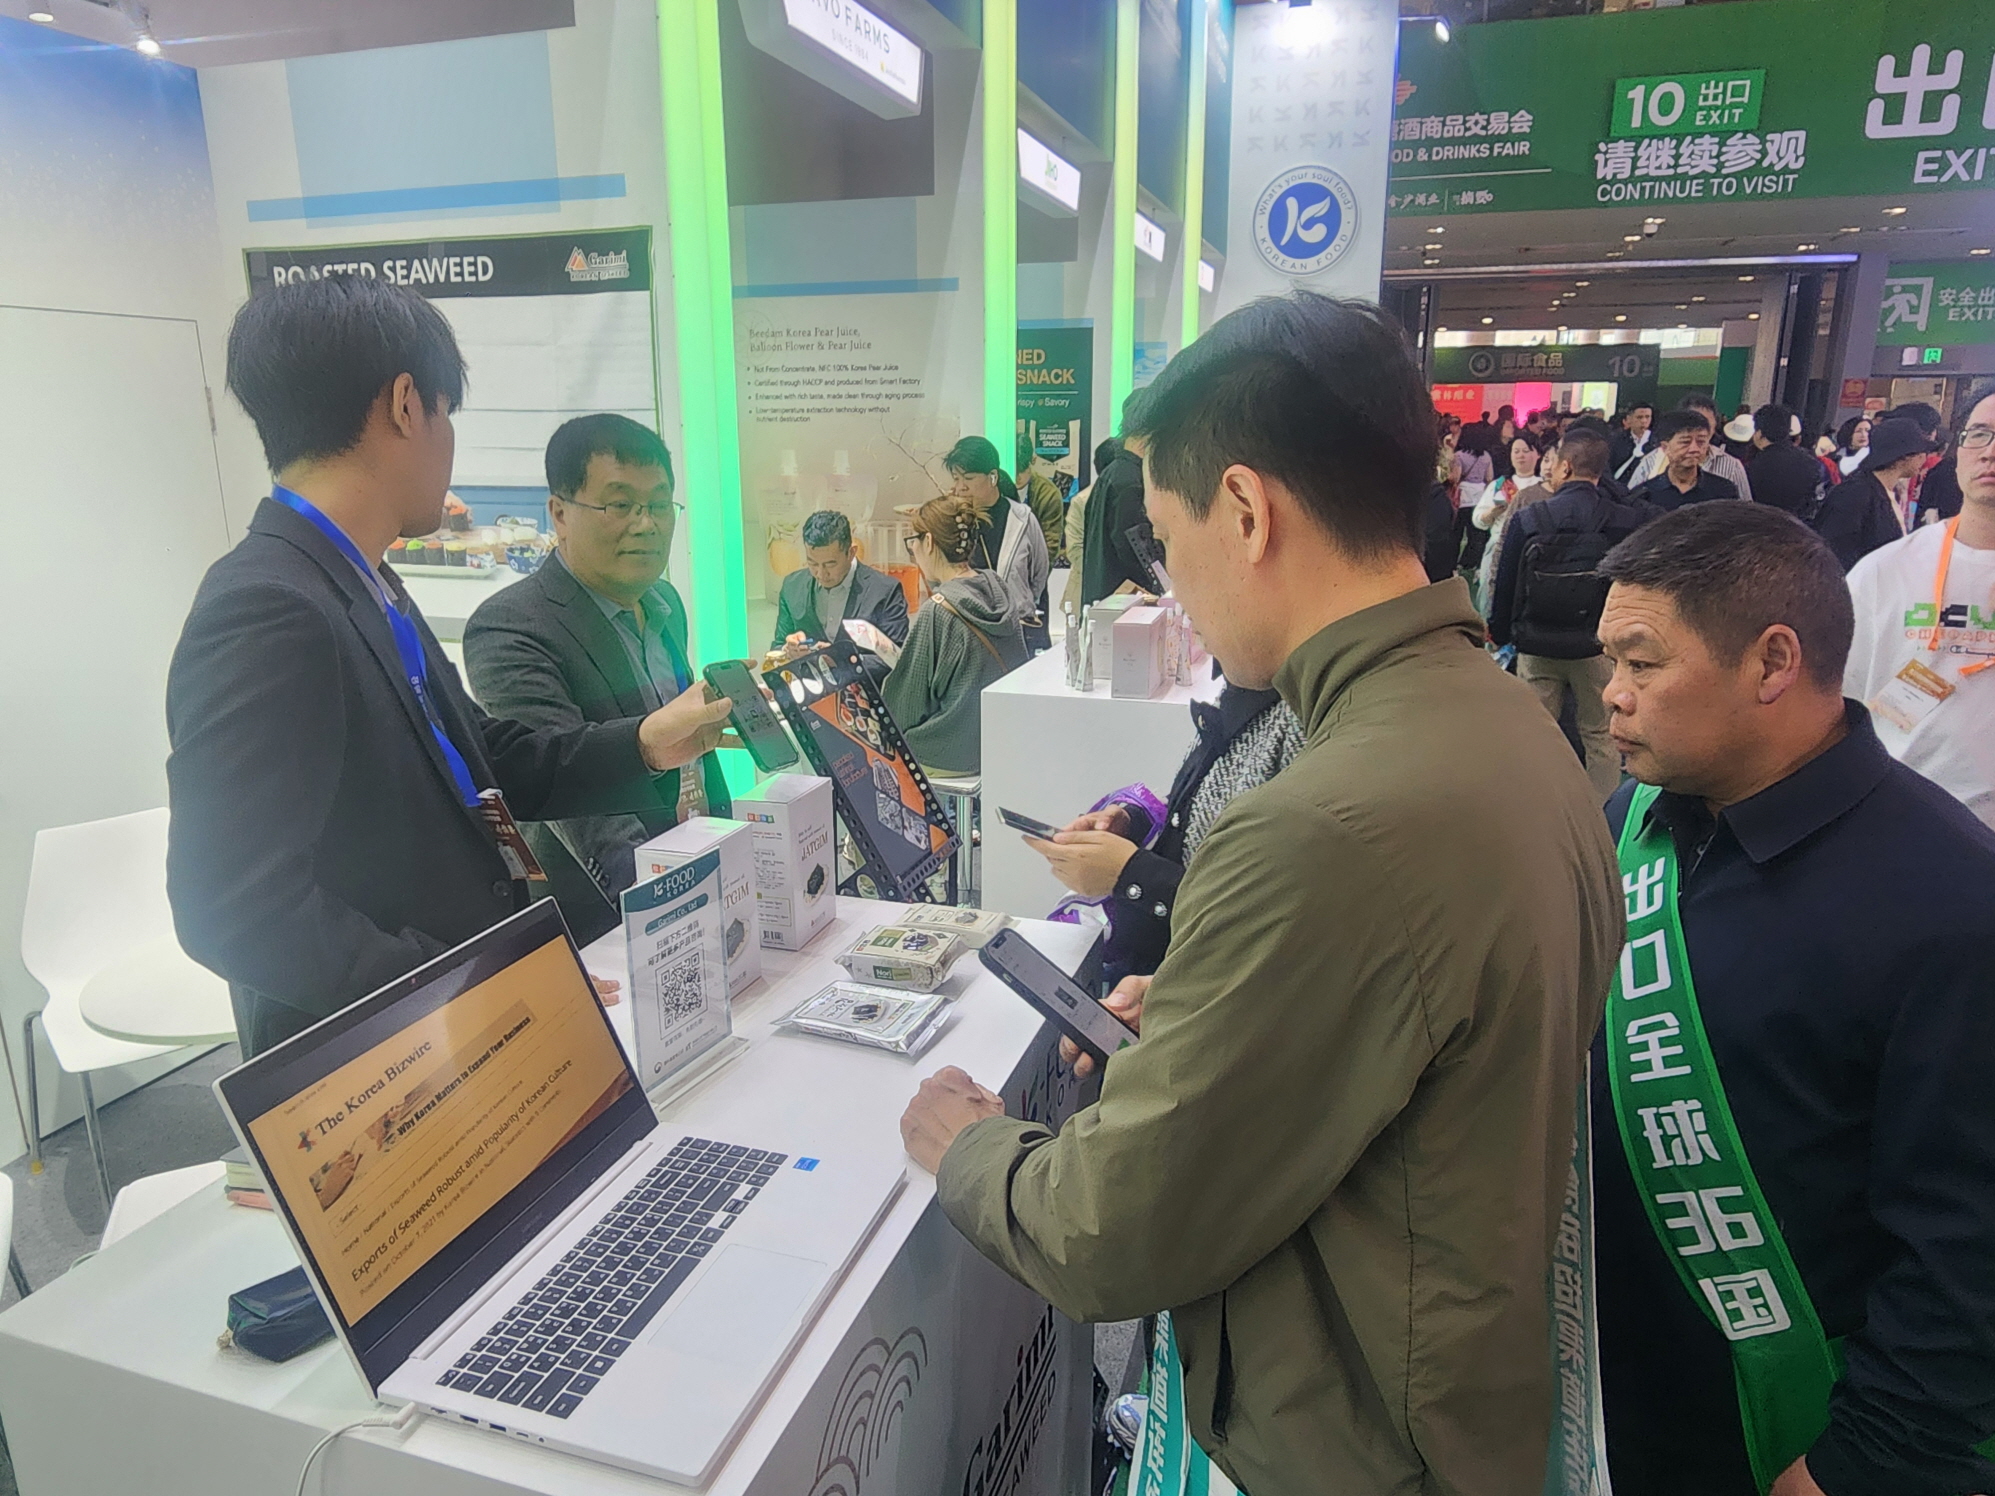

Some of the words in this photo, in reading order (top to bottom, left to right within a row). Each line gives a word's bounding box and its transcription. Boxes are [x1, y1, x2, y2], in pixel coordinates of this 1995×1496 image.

[845, 6, 891, 54] FARMS
[1627, 81, 1685, 128] 10
[1698, 79, 1751, 106] 出口
[1865, 43, 1995, 139] 出
[1695, 108, 1744, 126] EXIT
[1417, 148, 1428, 161] &
[1432, 143, 1490, 161] DRINKS
[1493, 141, 1531, 157] FAIR
[1594, 129, 1807, 180] 请继续参观
[1913, 147, 1995, 184] EXI
[1285, 172, 1308, 186] your
[1312, 172, 1334, 185] soul
[1334, 181, 1354, 211] food?
[1597, 179, 1705, 202] CONTINUE
[1709, 177, 1737, 197] TO
[1743, 174, 1798, 194] VISIT
[1260, 236, 1308, 271] KOREAN
[1316, 234, 1348, 266] FOOD
[382, 255, 494, 286] SEAWEED
[1947, 307, 1995, 321] EXIT
[785, 341, 815, 351] Flower
[817, 341, 825, 351] &
[828, 340, 848, 351] Pear
[849, 340, 872, 352] Juice
[786, 327, 812, 338] Korea
[814, 327, 834, 337] Pear
[833, 364, 849, 372] 100%
[883, 363, 899, 371] Juice
[1017, 368, 1076, 385] SNACK
[1608, 354, 1641, 378] 10
[824, 378, 835, 386] and
[836, 378, 863, 388] produced
[898, 377, 921, 387] Factory
[784, 392, 797, 400] with
[826, 392, 843, 400] made
[860, 392, 884, 401] through
[885, 392, 901, 401] aging
[835, 406, 867, 415] technology
[868, 405, 890, 414] without
[1044, 397, 1070, 408] Savory
[779, 415, 811, 423] destruction
[653, 866, 695, 899] K-FOOD
[666, 879, 696, 898] KOREA
[722, 881, 750, 911] TGIM
[687, 900, 698, 912] Ltd
[314, 1110, 345, 1137] The
[344, 1078, 386, 1115] Korea
[384, 1040, 433, 1083] Bizwire
[397, 1119, 416, 1137] Why
[413, 1099, 437, 1122] Korea
[434, 1077, 462, 1103] Matters
[460, 1070, 469, 1080] to
[467, 1050, 491, 1074] Expand
[489, 1039, 505, 1055] Your
[351, 1242, 389, 1282] Exports
[388, 1228, 399, 1245] of
[398, 1192, 437, 1235] Seaweed
[436, 1165, 466, 1197] Robust
[465, 1144, 485, 1170] amid
[482, 1111, 521, 1149] Popularity
[518, 1101, 527, 1115] of
[525, 1082, 550, 1107] Korean
[547, 1059, 573, 1084] Culture
[1003, 1369, 1057, 1496] AWEED
